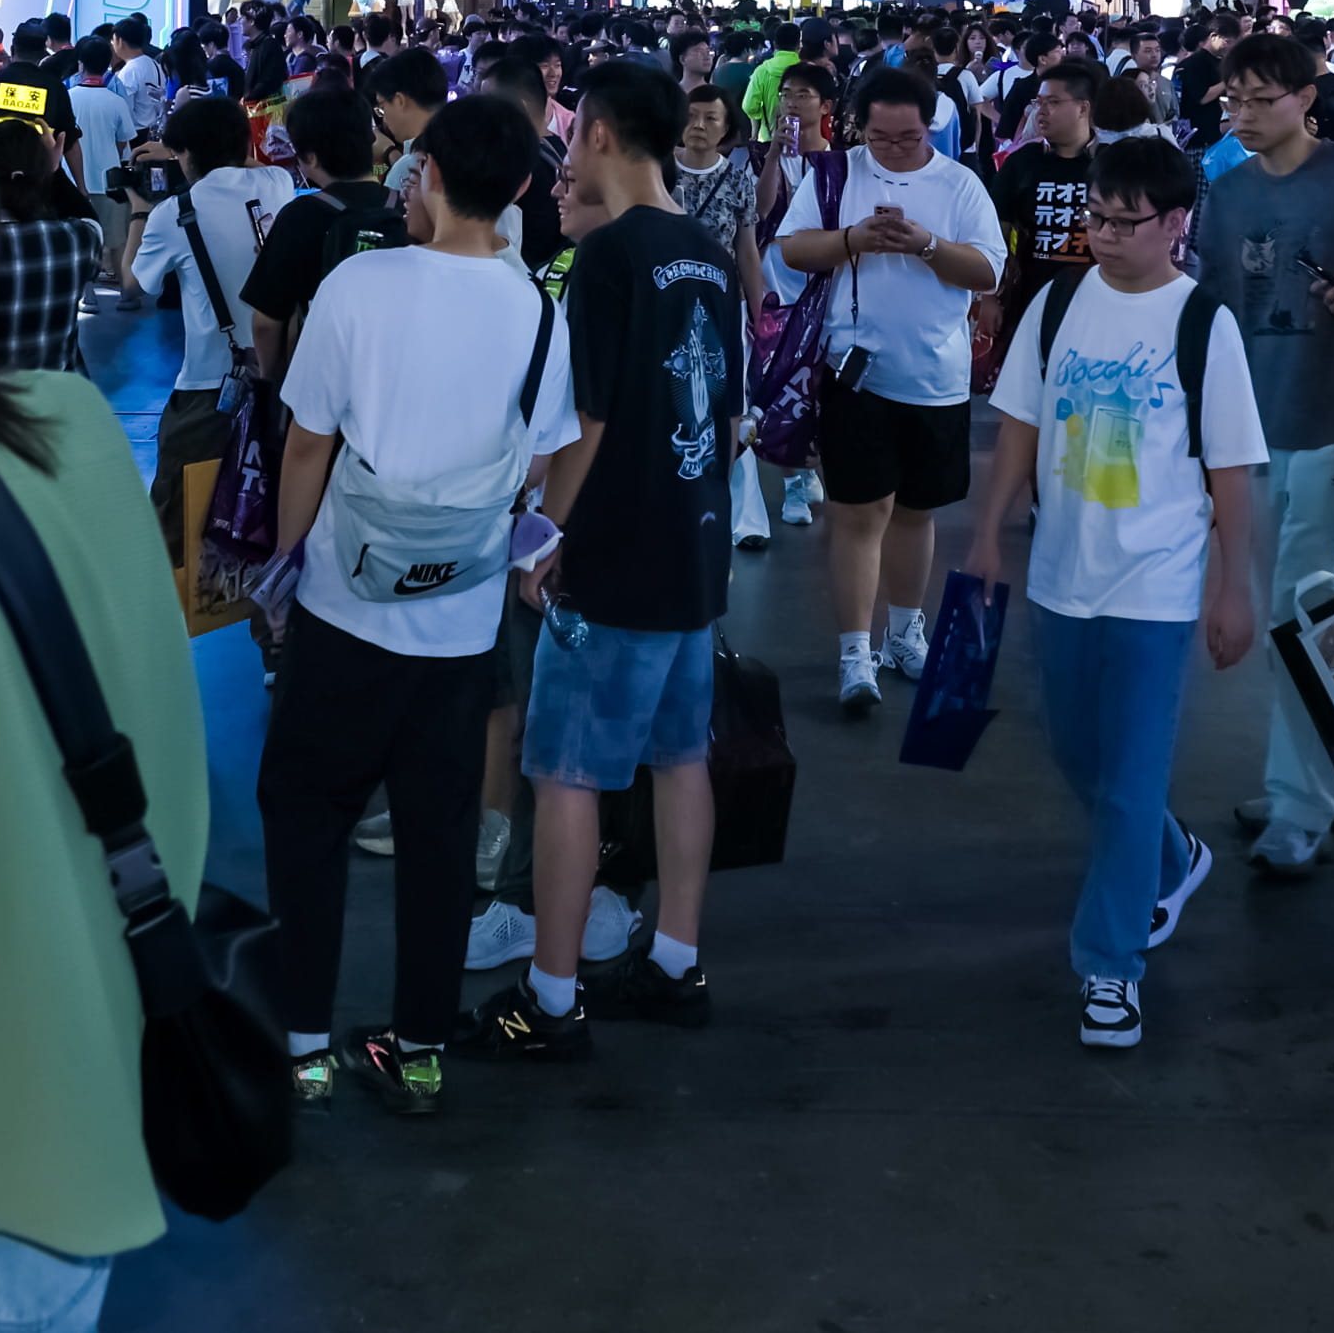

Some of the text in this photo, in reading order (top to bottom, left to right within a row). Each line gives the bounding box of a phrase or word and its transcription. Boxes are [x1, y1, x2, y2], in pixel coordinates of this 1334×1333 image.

[5, 86, 41, 102] 保安
[2, 98, 40, 110] BAOAN
[406, 561, 459, 583] NIKE
